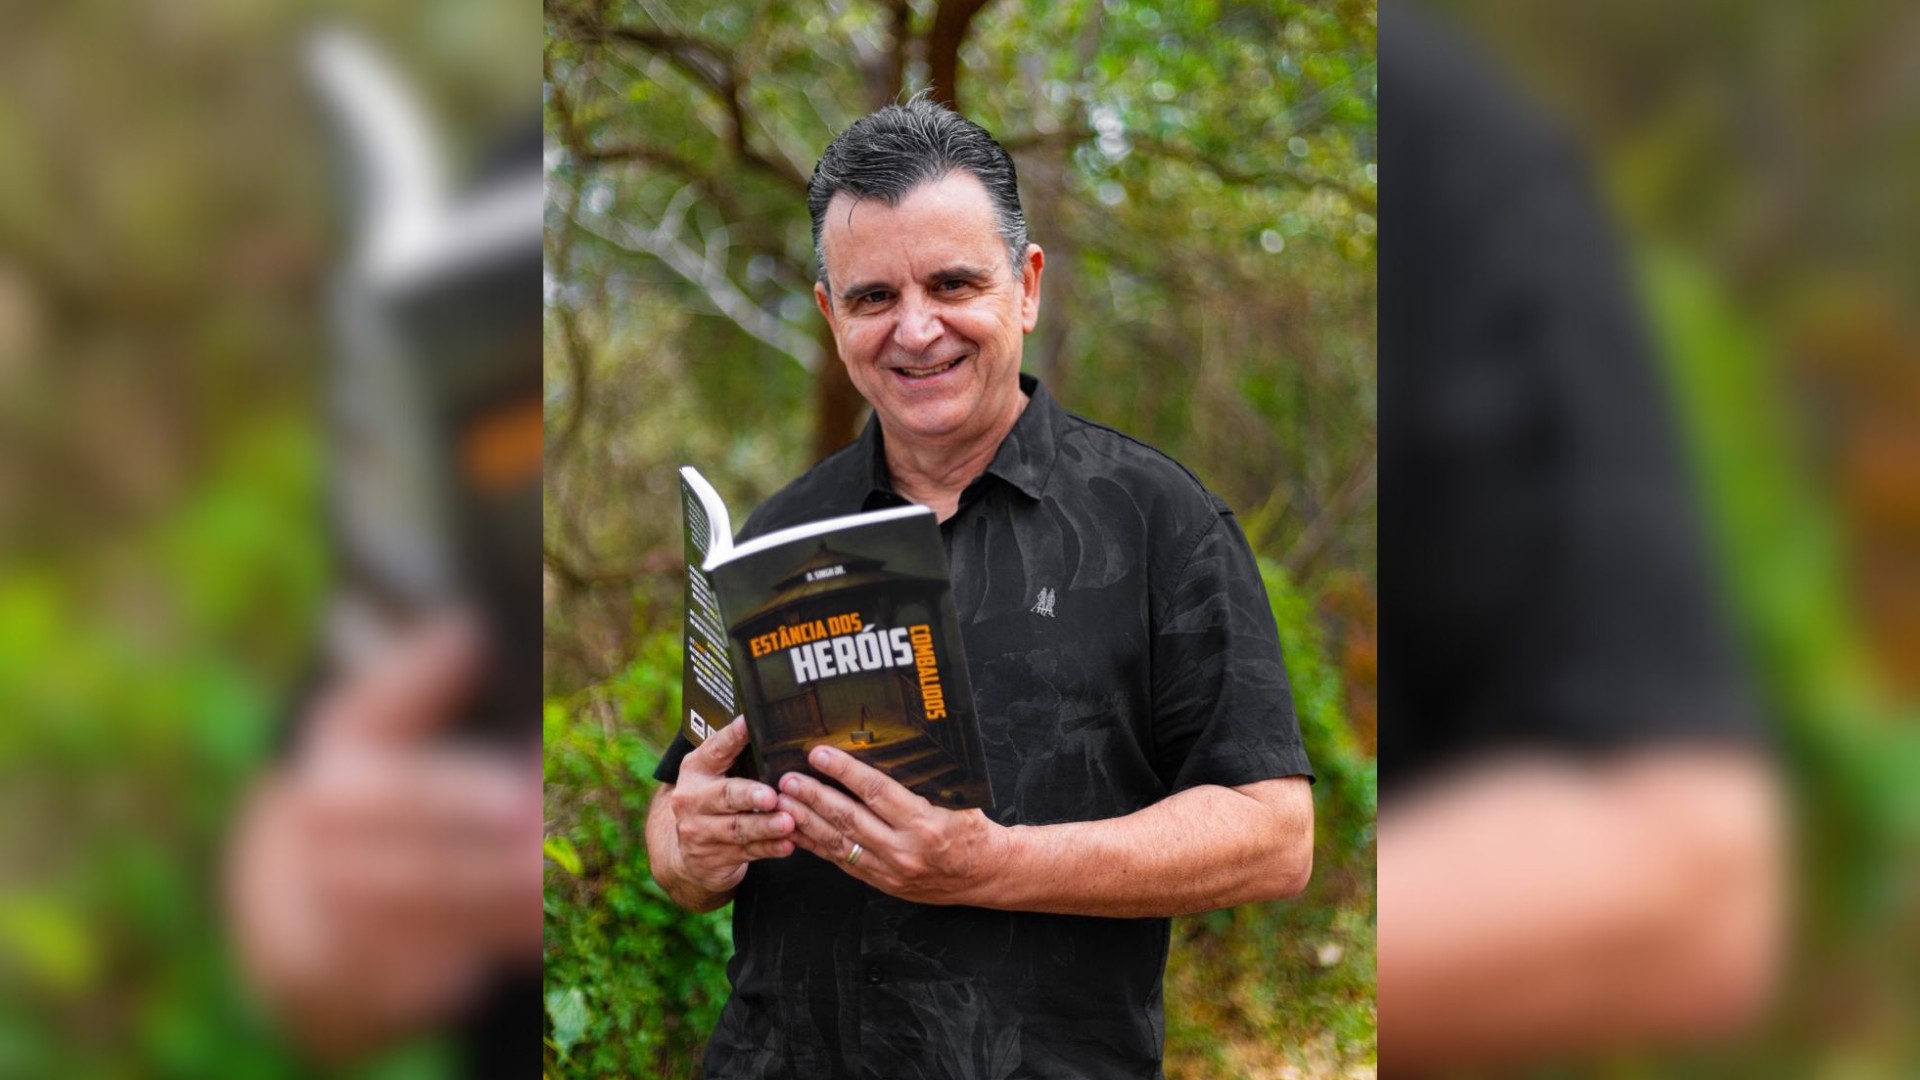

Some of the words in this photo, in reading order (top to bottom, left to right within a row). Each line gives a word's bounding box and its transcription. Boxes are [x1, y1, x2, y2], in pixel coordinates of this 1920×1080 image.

[750, 620, 828, 657] ESTÂNCIA
[828, 613, 863, 634] DOS
[790, 623, 914, 684] HERÓIS
[909, 624, 947, 721] COMBALIDOS
